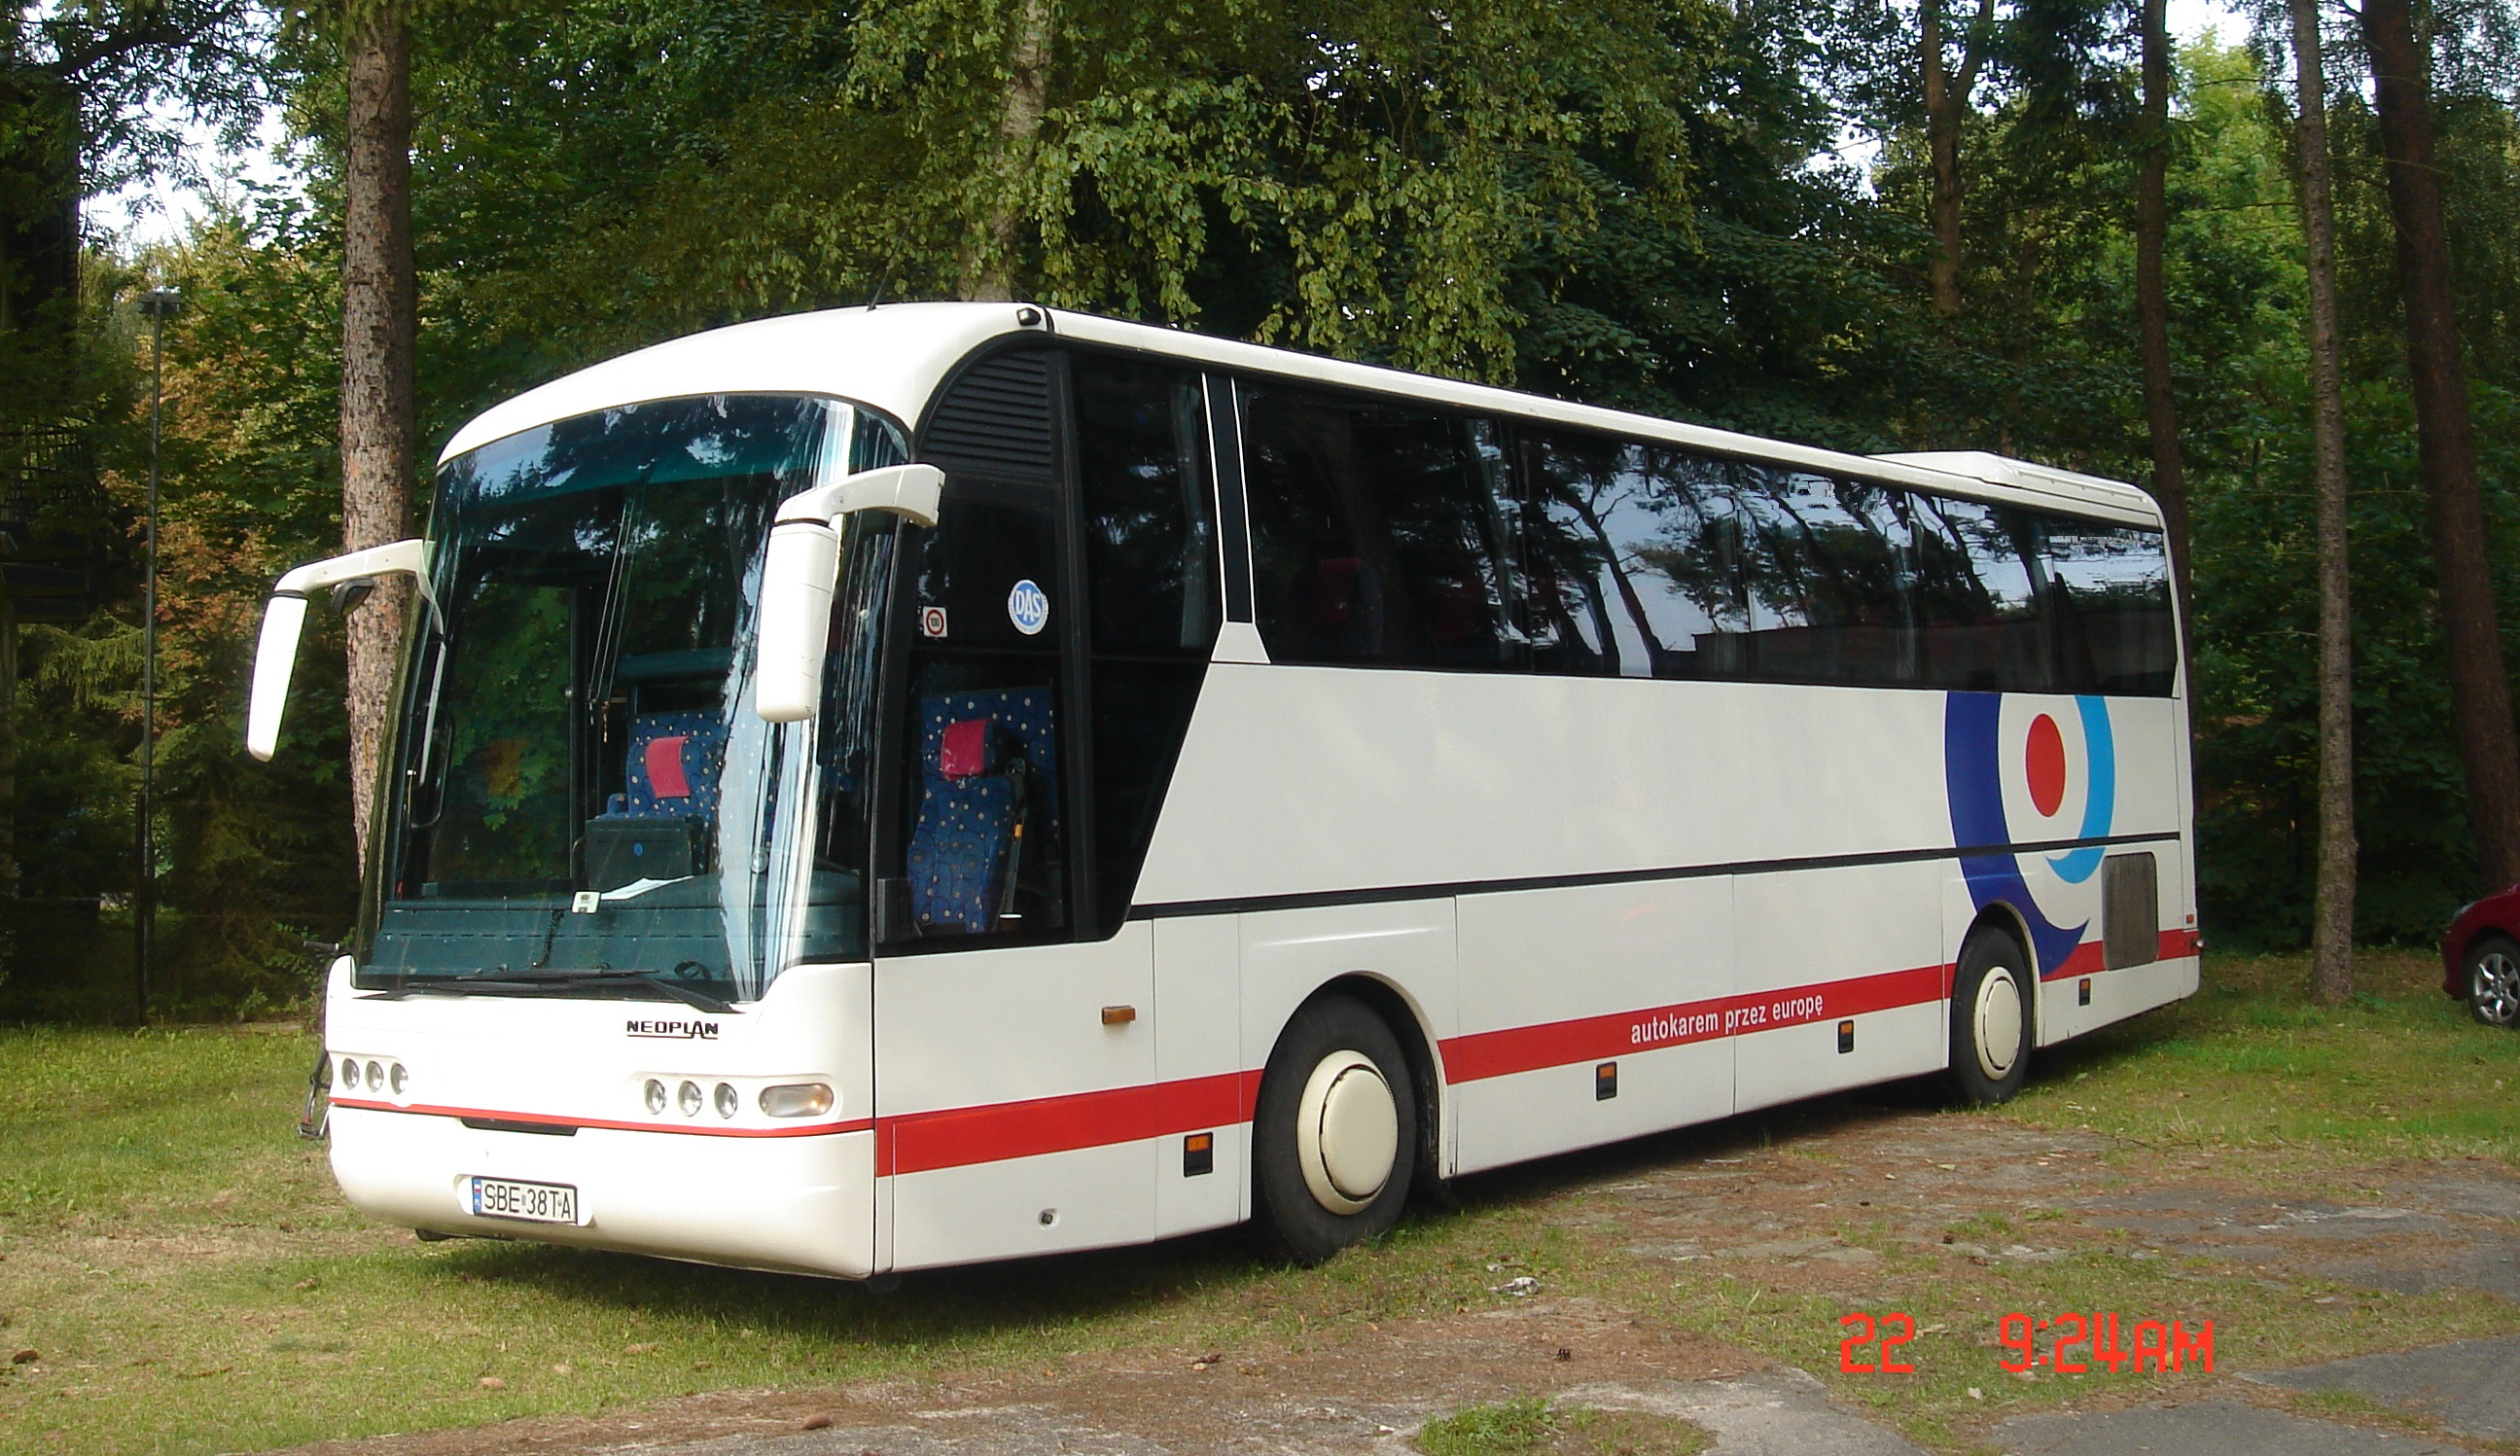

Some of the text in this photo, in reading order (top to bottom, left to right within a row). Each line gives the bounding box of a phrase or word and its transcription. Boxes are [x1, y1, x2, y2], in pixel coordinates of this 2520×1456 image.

[1016, 589, 1041, 621] DAS
[626, 1020, 718, 1039] NEOPLAN
[1631, 995, 1823, 1044] autokarem przez europę
[484, 1184, 571, 1219] SBE 38TA
